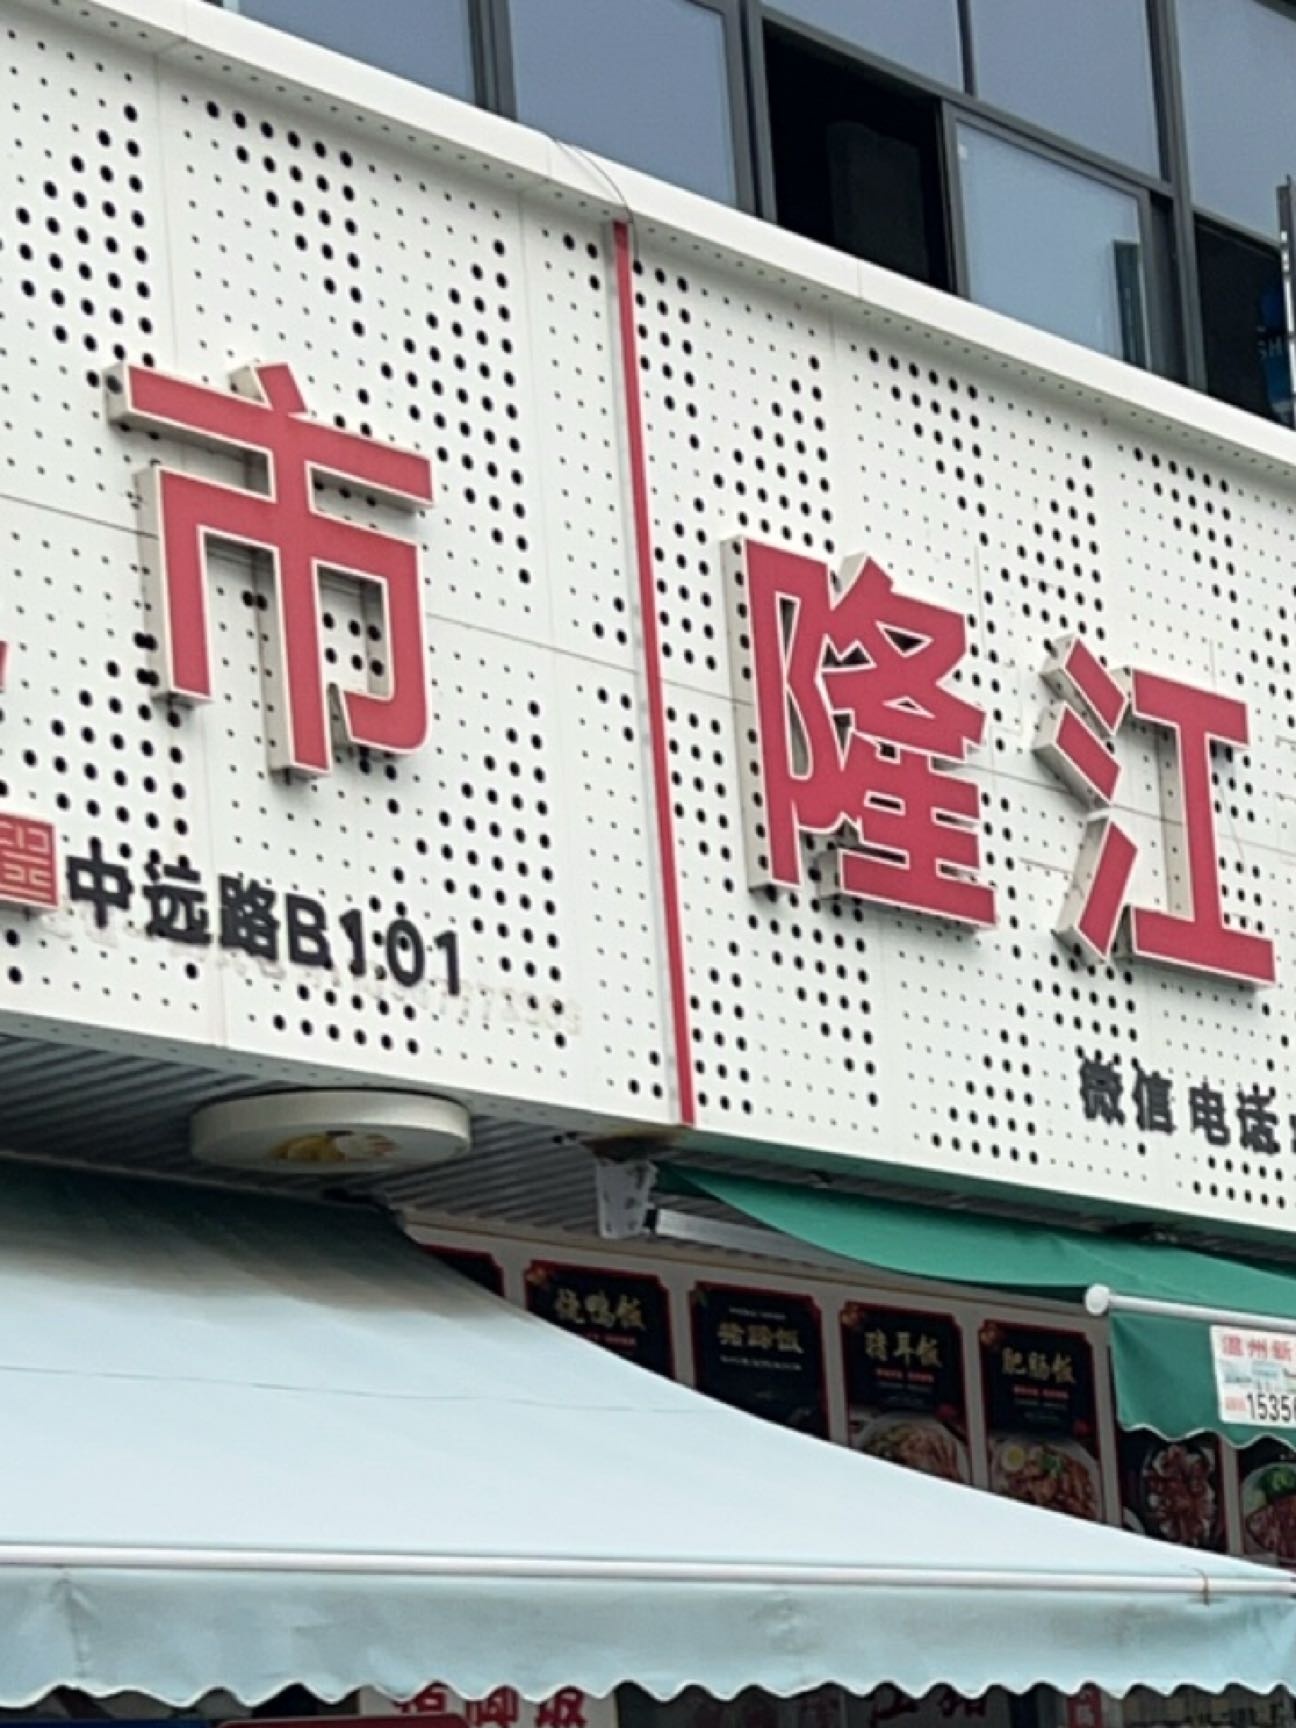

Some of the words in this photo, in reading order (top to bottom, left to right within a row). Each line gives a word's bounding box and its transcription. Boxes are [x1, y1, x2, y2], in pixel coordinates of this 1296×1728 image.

[0, 362, 433, 774] 市
[67, 838, 463, 995] 中远路B101
